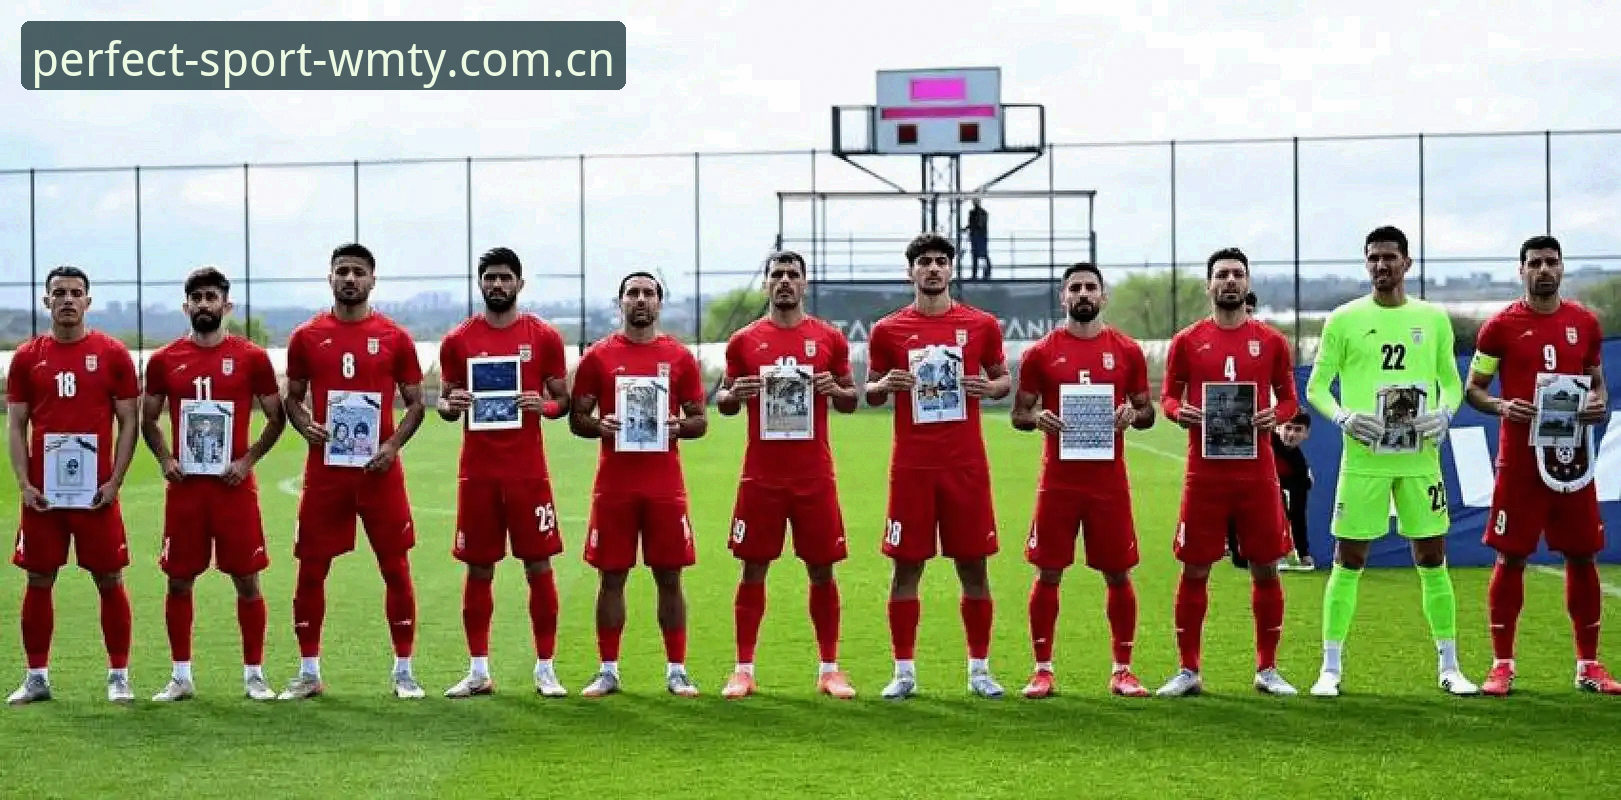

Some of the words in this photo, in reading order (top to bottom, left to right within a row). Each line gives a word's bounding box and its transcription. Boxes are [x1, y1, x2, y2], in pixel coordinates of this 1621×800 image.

[342, 352, 355, 378] 8
[1224, 355, 1236, 382] 4
[1381, 344, 1406, 370] 22
[1543, 344, 1557, 370] 9
[55, 371, 77, 397] 18
[192, 376, 212, 400] 11
[1494, 510, 1507, 536] 9
